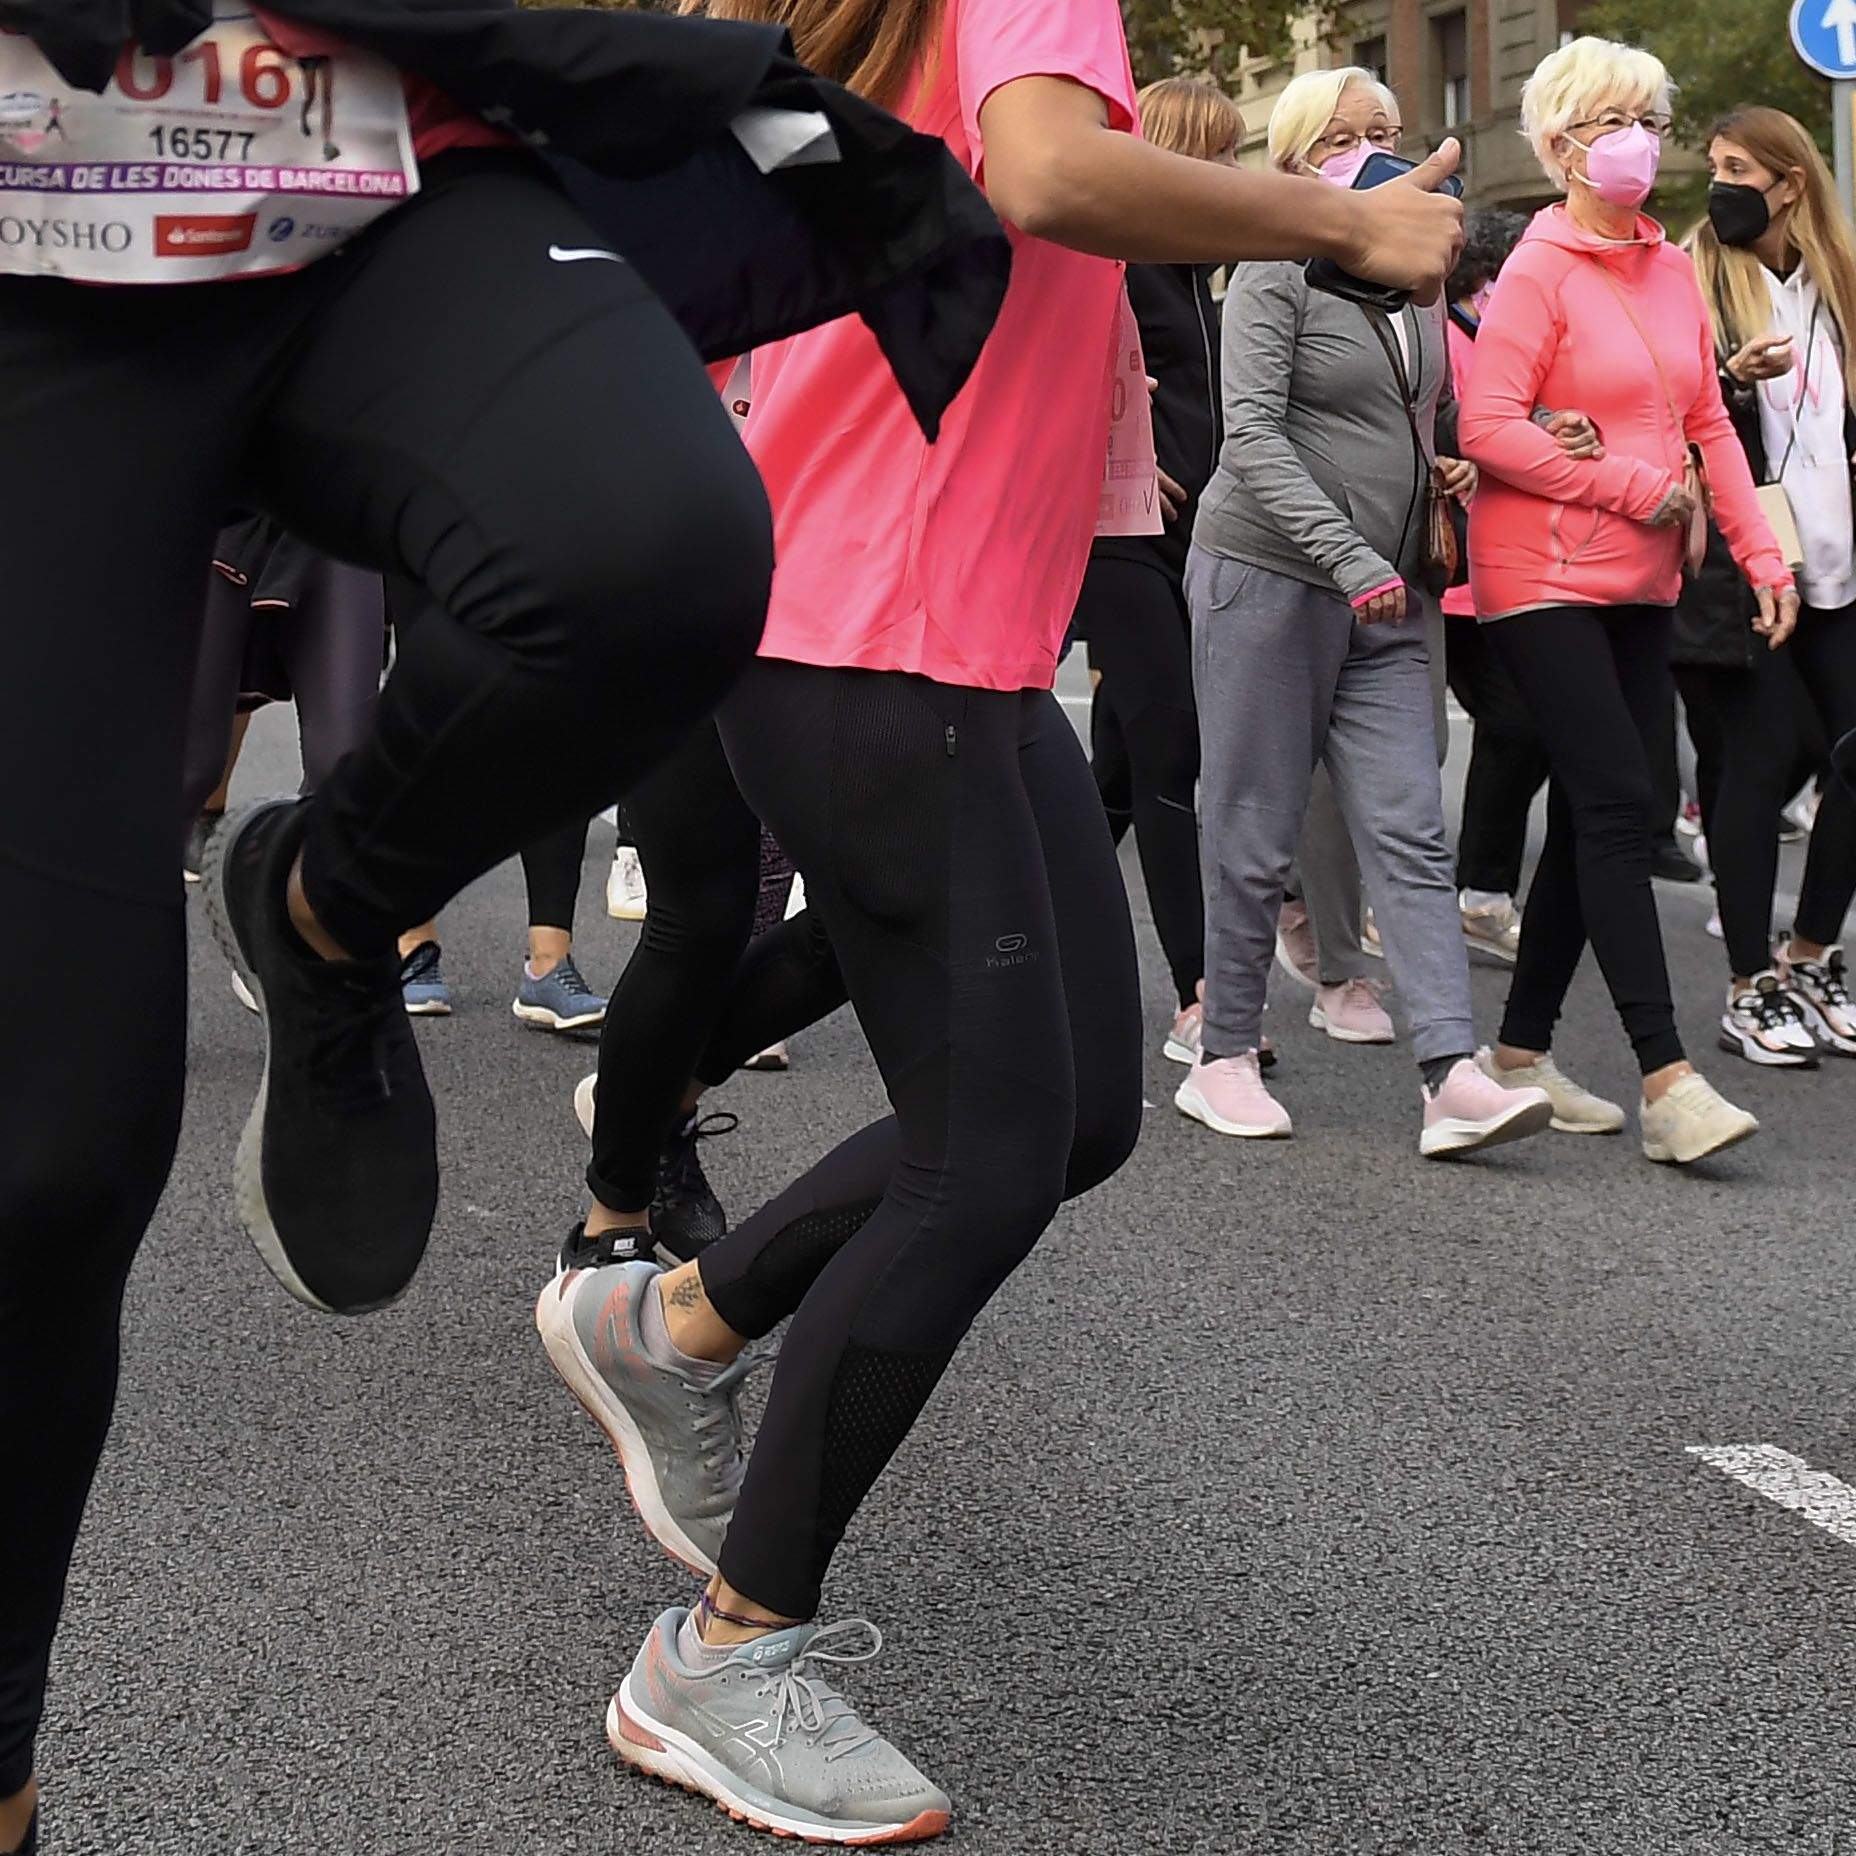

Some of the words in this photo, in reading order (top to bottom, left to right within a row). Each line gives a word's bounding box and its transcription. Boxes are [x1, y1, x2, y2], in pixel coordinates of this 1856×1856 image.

[149, 124, 255, 161] 16577
[71, 166, 105, 189] DE
[110, 165, 157, 188] LES
[163, 166, 242, 189] DONES
[245, 169, 274, 189] DE
[278, 170, 402, 194] BARCELONA
